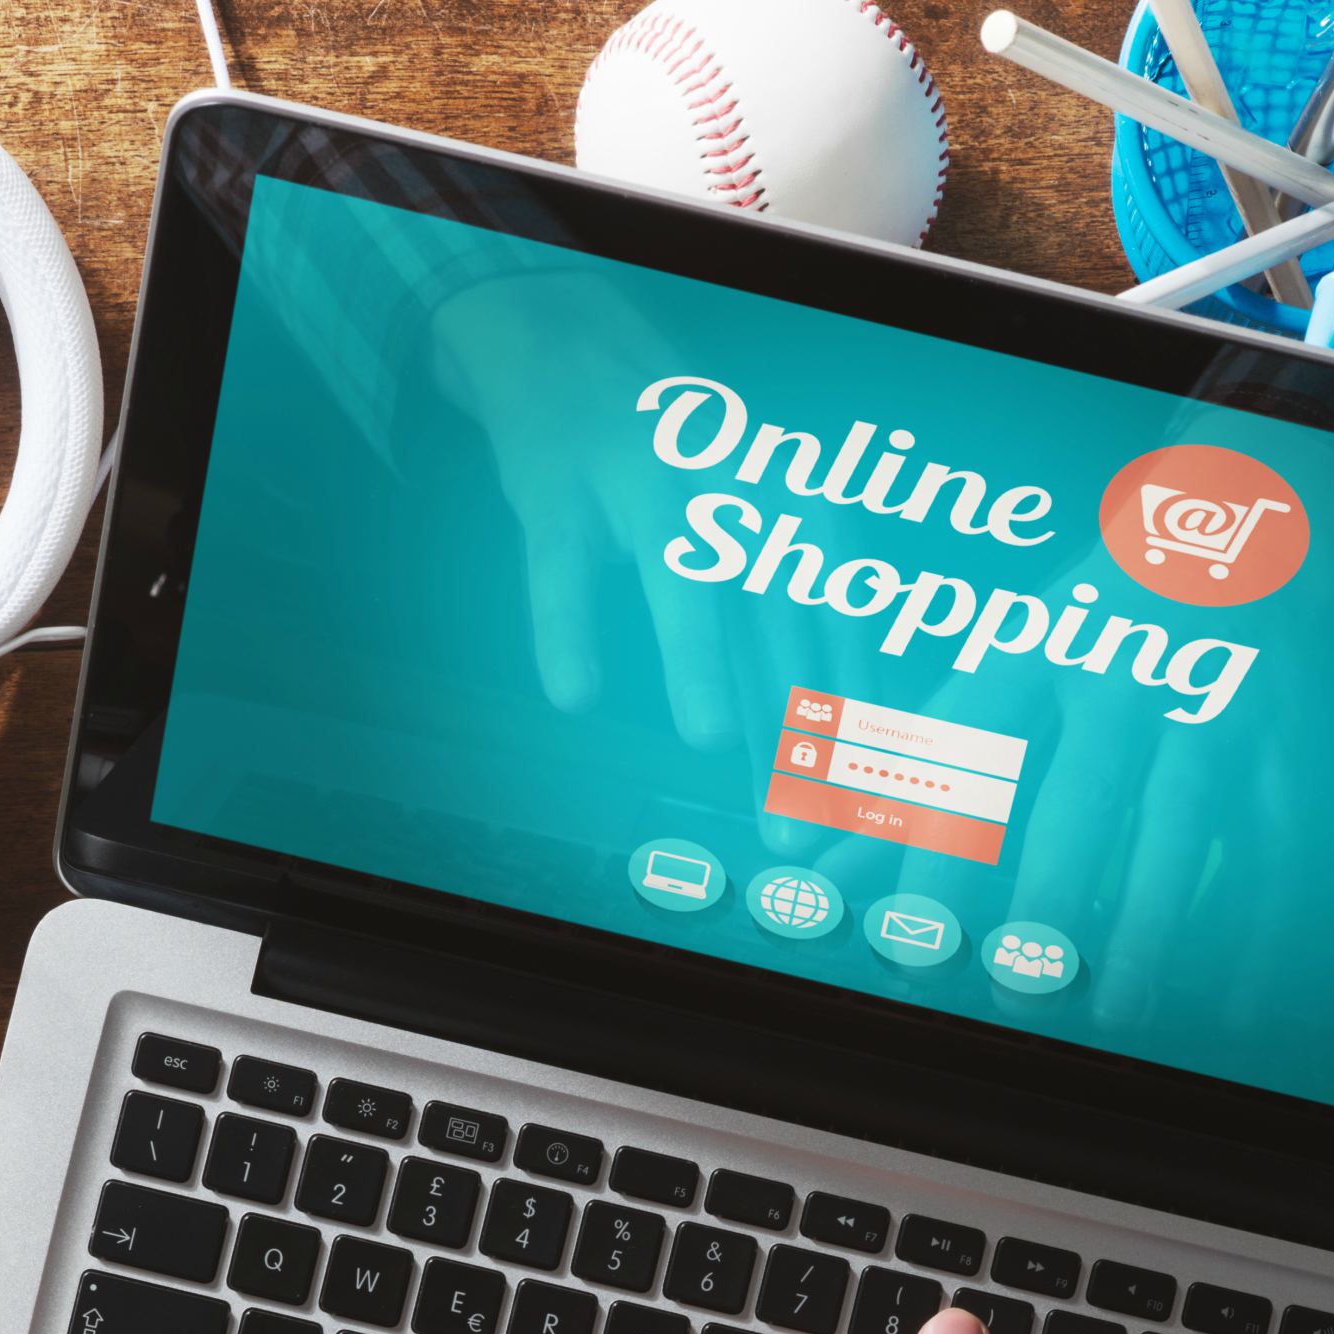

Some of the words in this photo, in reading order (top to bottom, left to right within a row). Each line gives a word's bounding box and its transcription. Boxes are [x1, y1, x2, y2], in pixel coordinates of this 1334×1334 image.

[636, 375, 1056, 547] Online
[664, 493, 1260, 725] Shopping
[858, 719, 934, 745] Username
[857, 806, 885, 825] Log
[889, 814, 903, 827] in
[163, 1055, 188, 1070] esc
[293, 1095, 304, 1106] F1
[386, 1118, 399, 1130] F2
[482, 1141, 495, 1153] F3
[576, 1164, 590, 1176] F4
[331, 1183, 346, 1205] 2
[429, 1176, 445, 1197] £
[674, 1186, 686, 1198] F5
[422, 1205, 437, 1227] 3
[522, 1197, 537, 1219] $
[767, 1208, 780, 1220] F6
[515, 1228, 530, 1249] 4
[614, 1219, 631, 1241] %
[864, 1231, 878, 1242] F7
[264, 1248, 284, 1272] Q
[607, 1249, 623, 1271] 5
[706, 1241, 722, 1263] &
[355, 1267, 380, 1293] W
[700, 1272, 714, 1292] 6
[1055, 1277, 1068, 1289] F9
[450, 1290, 466, 1314] E
[793, 1293, 809, 1314] 7
[1146, 1299, 1164, 1312] F10
[466, 1313, 485, 1333] €
